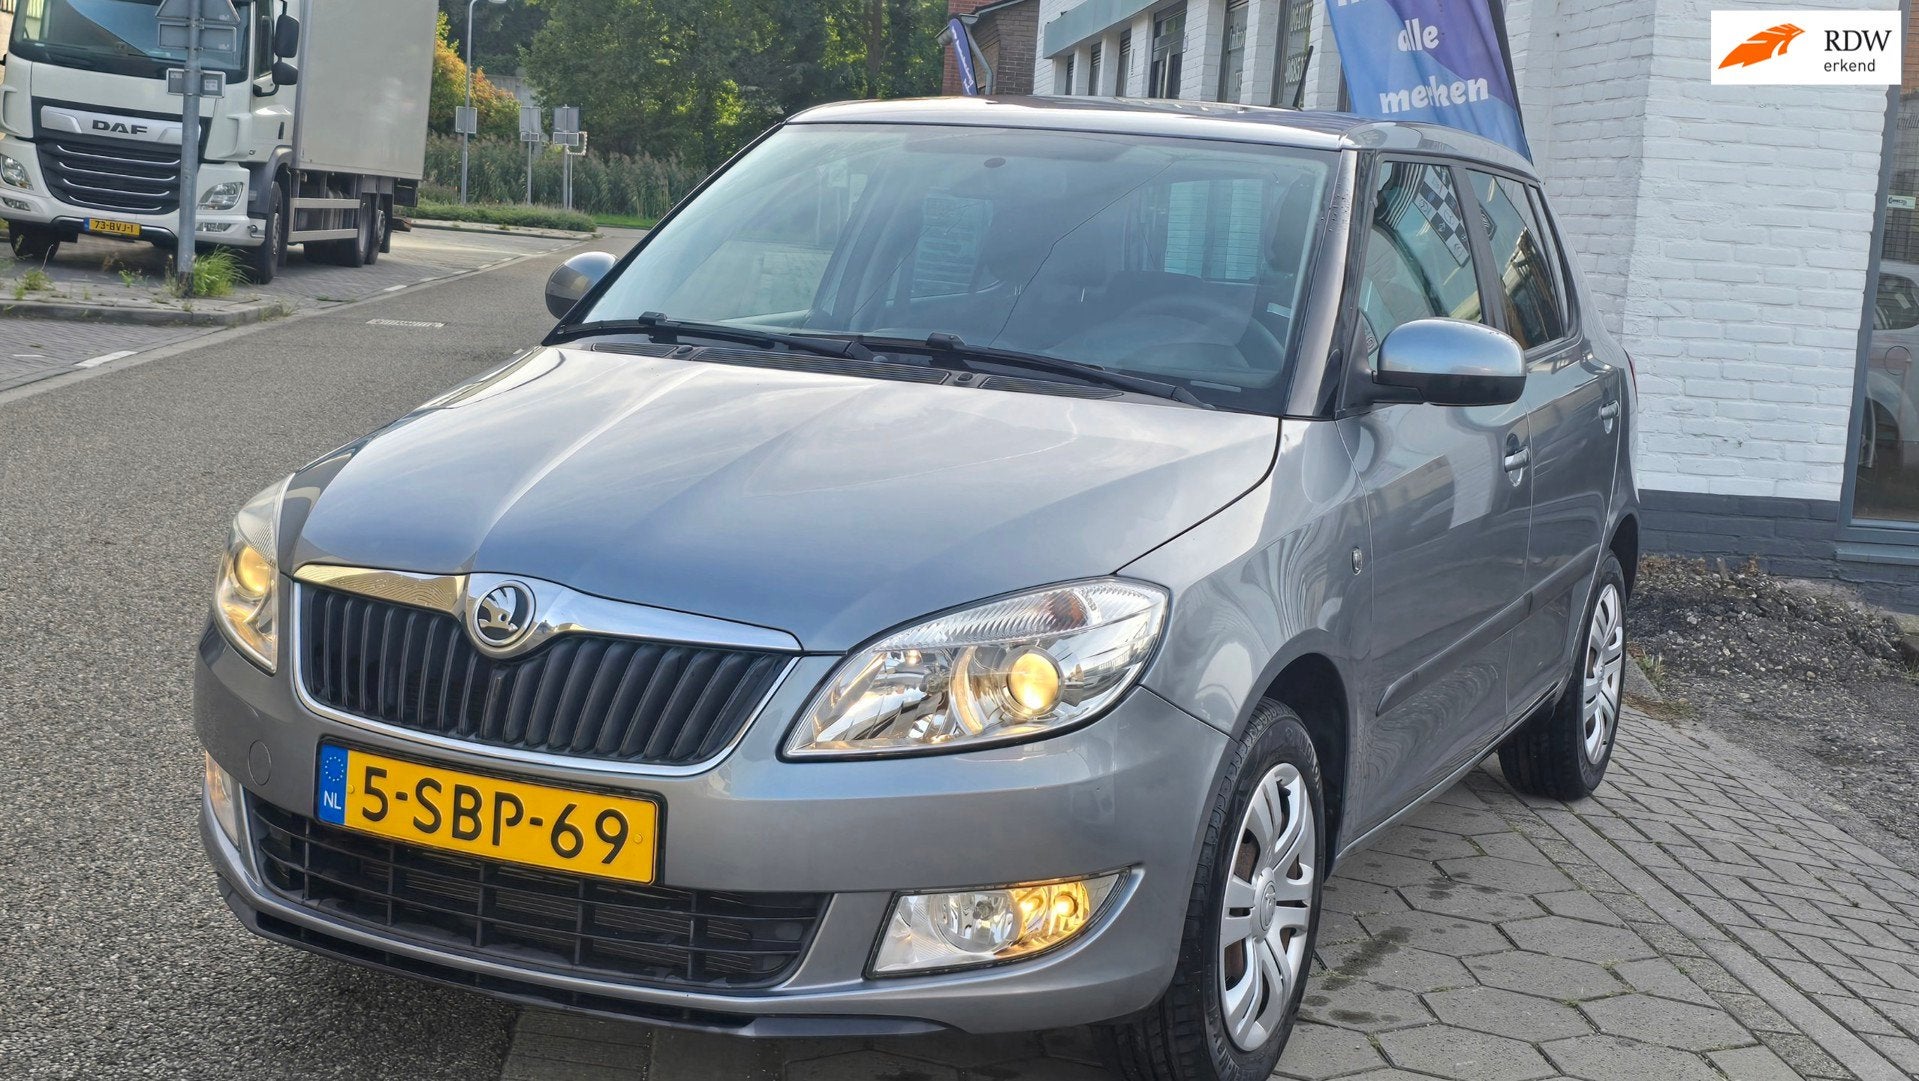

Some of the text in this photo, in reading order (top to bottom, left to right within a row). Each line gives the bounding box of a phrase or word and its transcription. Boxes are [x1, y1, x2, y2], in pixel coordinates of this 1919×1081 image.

[1397, 18, 1440, 52] alle
[1379, 75, 1489, 114] merken
[92, 119, 148, 135] DAF
[94, 220, 135, 233] 73-BVJ-1
[323, 790, 342, 811] NL
[361, 765, 630, 866] 5-SBP-69
